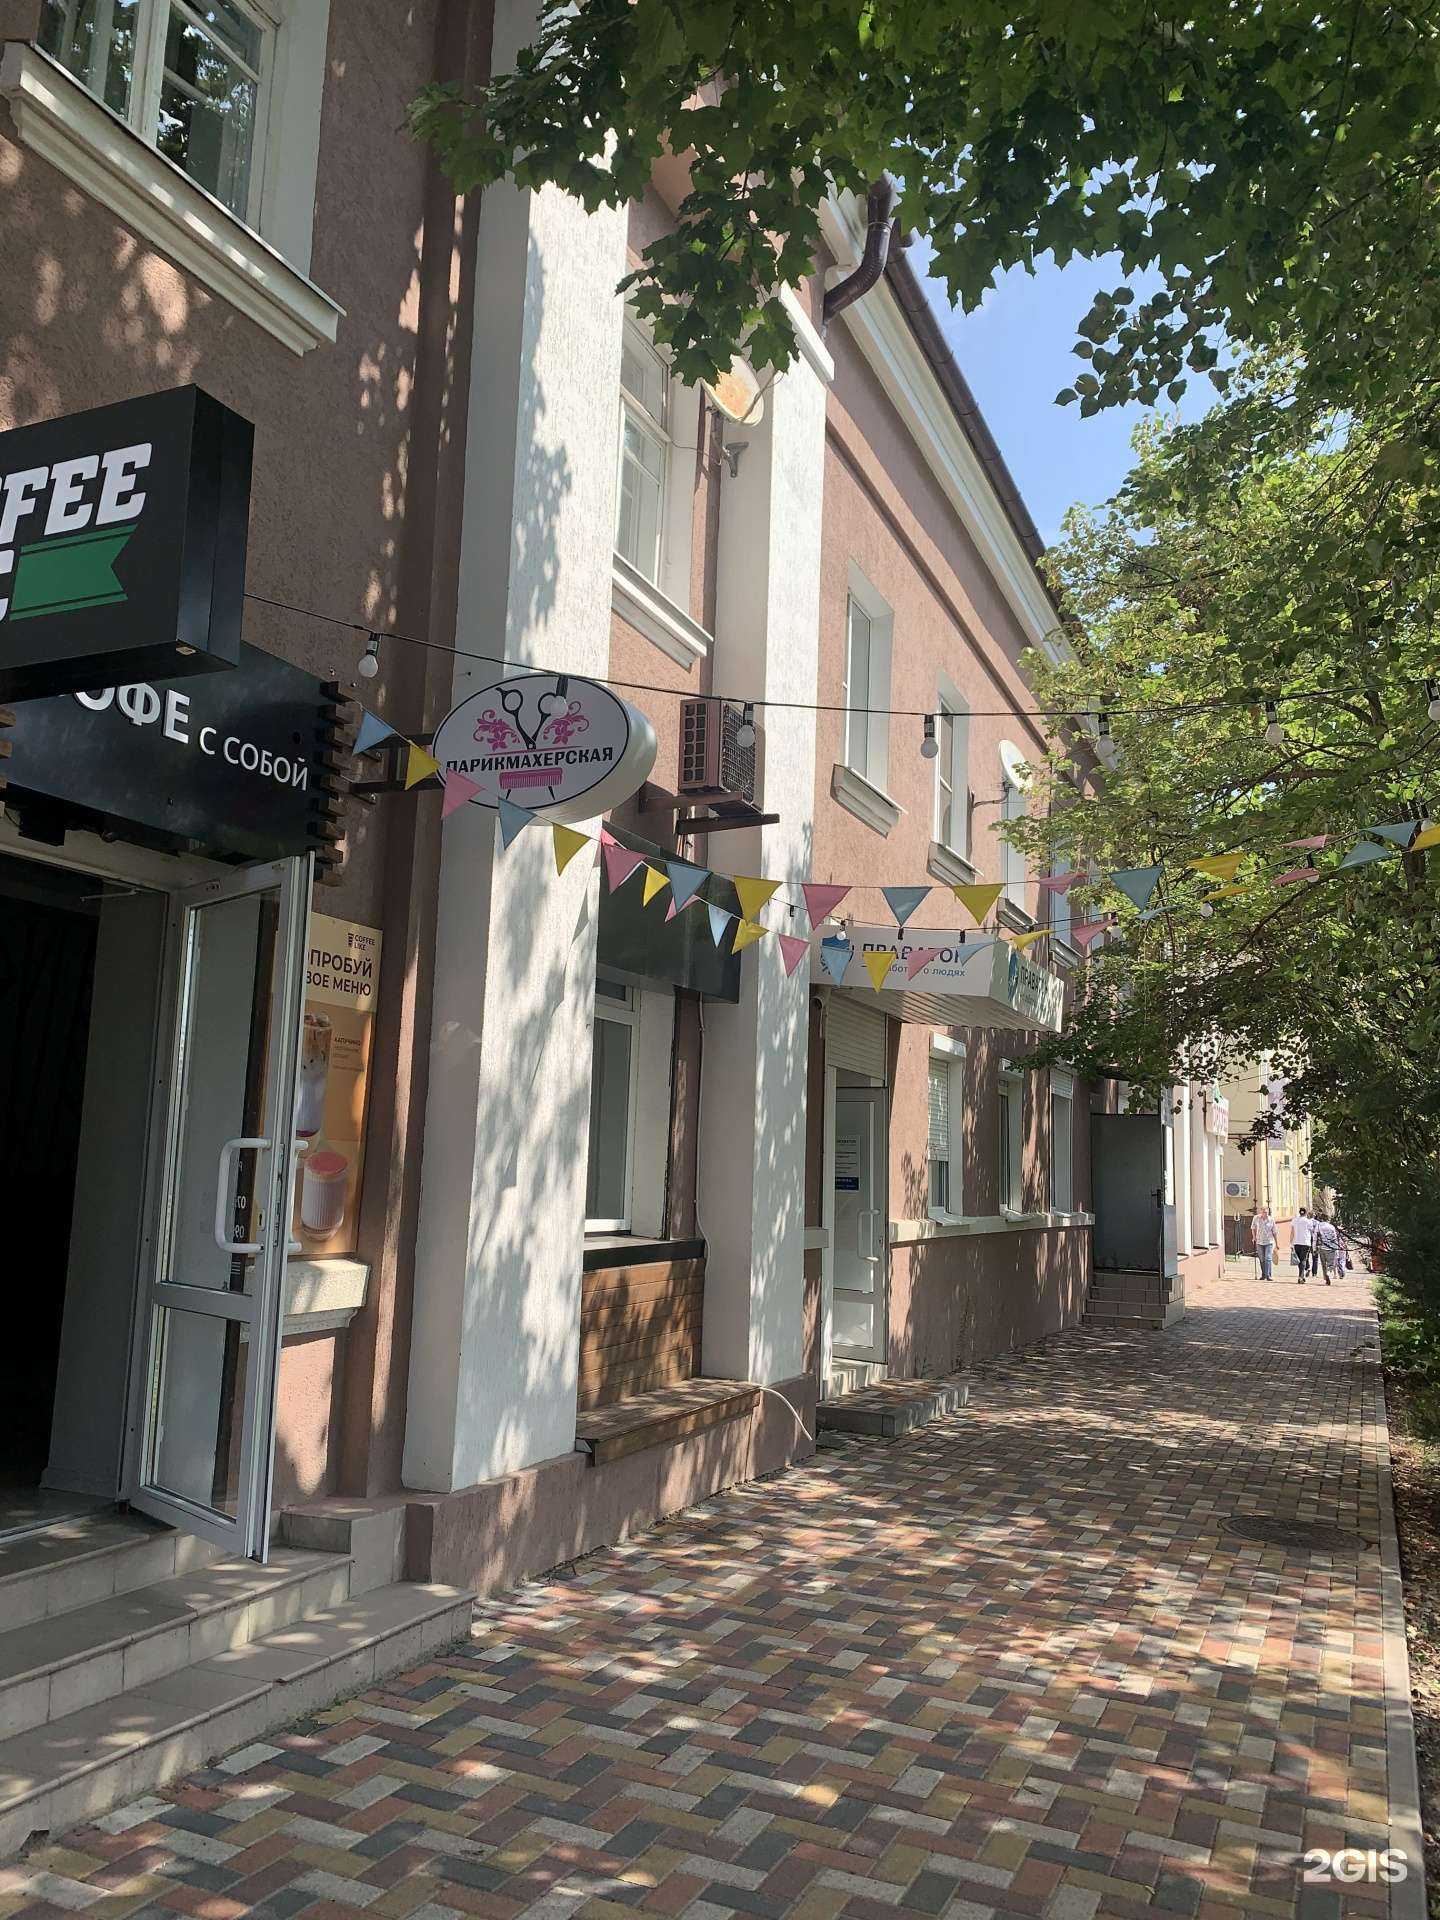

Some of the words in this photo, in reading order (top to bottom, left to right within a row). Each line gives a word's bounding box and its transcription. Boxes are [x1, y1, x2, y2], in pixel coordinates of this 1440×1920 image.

[0, 442, 152, 545] FEE
[223, 735, 311, 791] СОБОЙ
[446, 747, 613, 774] ПАРИКМАХЕРСКАЯ
[354, 934, 376, 946] COFFEE
[354, 941, 367, 951] LIKE
[307, 948, 373, 979] ПРОБУЙ
[333, 976, 371, 996] МЕНЮ
